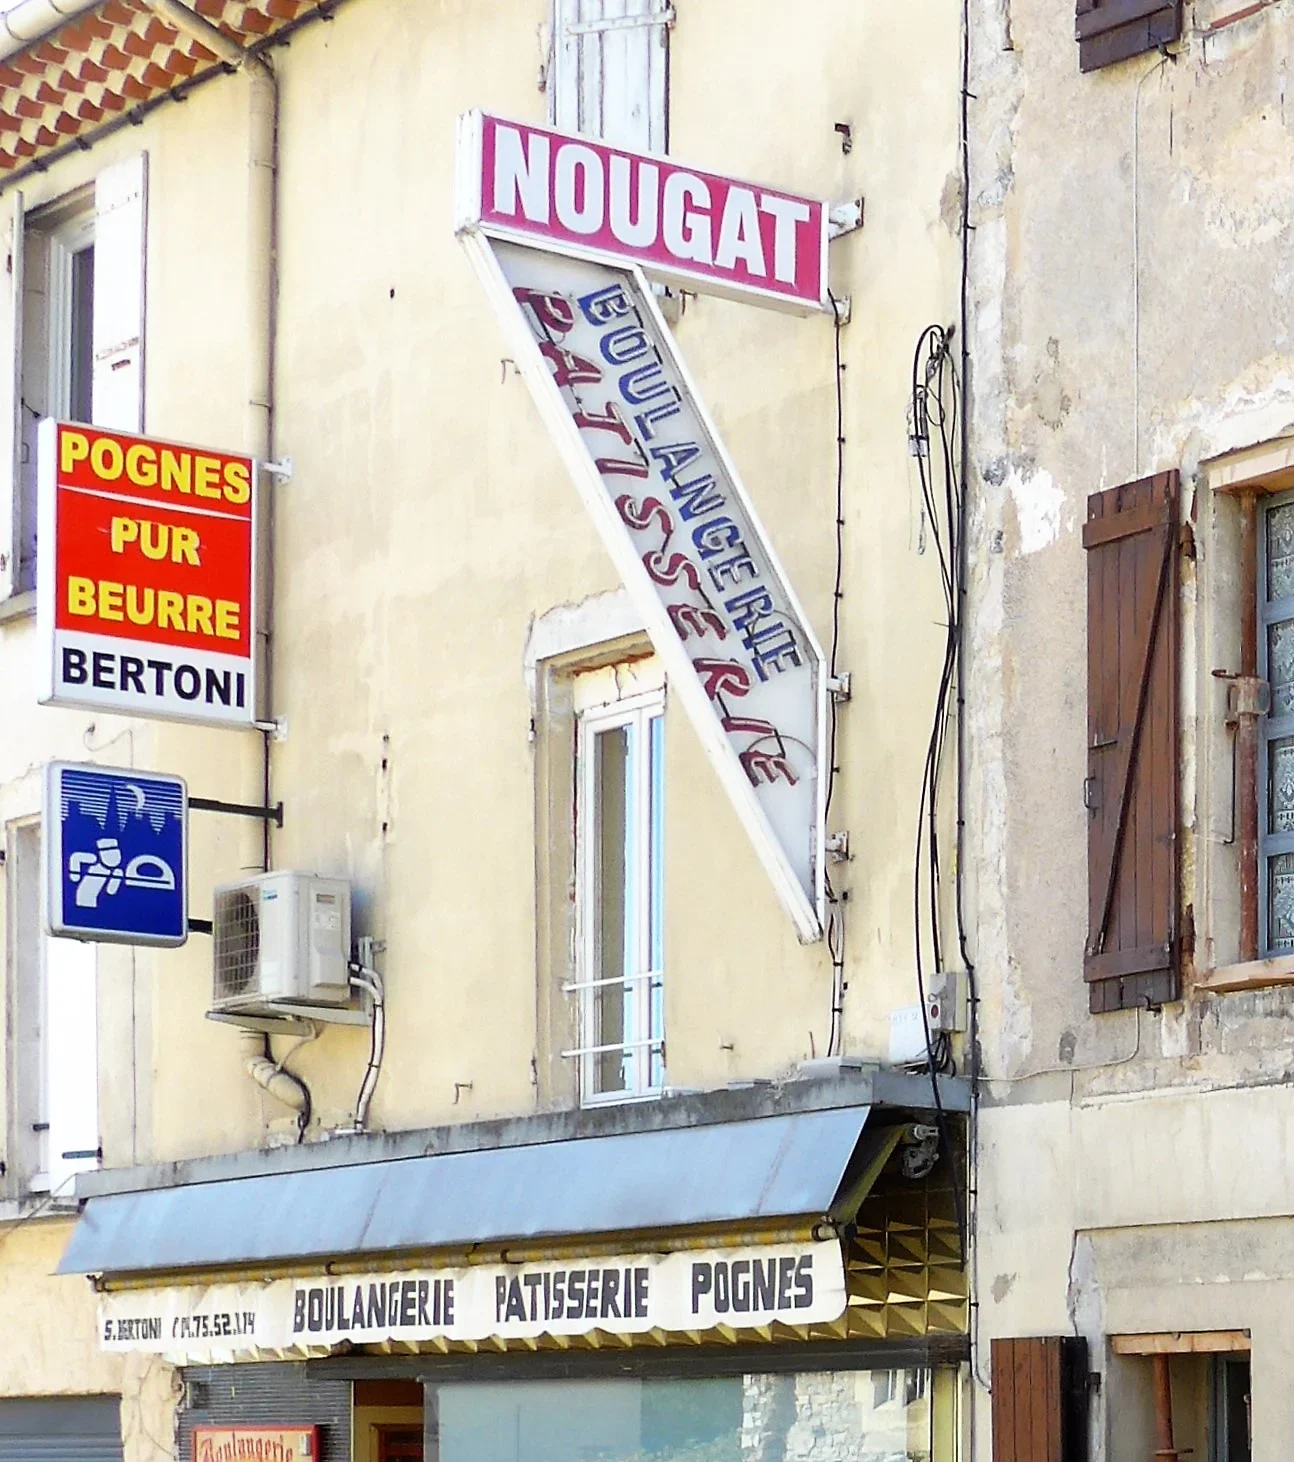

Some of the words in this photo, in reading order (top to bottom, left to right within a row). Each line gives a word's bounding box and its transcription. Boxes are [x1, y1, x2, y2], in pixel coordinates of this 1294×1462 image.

[494, 124, 811, 286] NOUGAT
[60, 431, 252, 504] POGNES
[576, 283, 803, 684] BOULANGERIE
[110, 516, 202, 566] PUR
[512, 287, 800, 788] PATISSERIE
[67, 576, 241, 641] BEURRE
[61, 647, 246, 708] BERTONI
[293, 1278, 455, 1334] BOULANGERIE
[495, 1267, 649, 1323] PATISSERIE
[691, 1254, 813, 1315] POGNES
